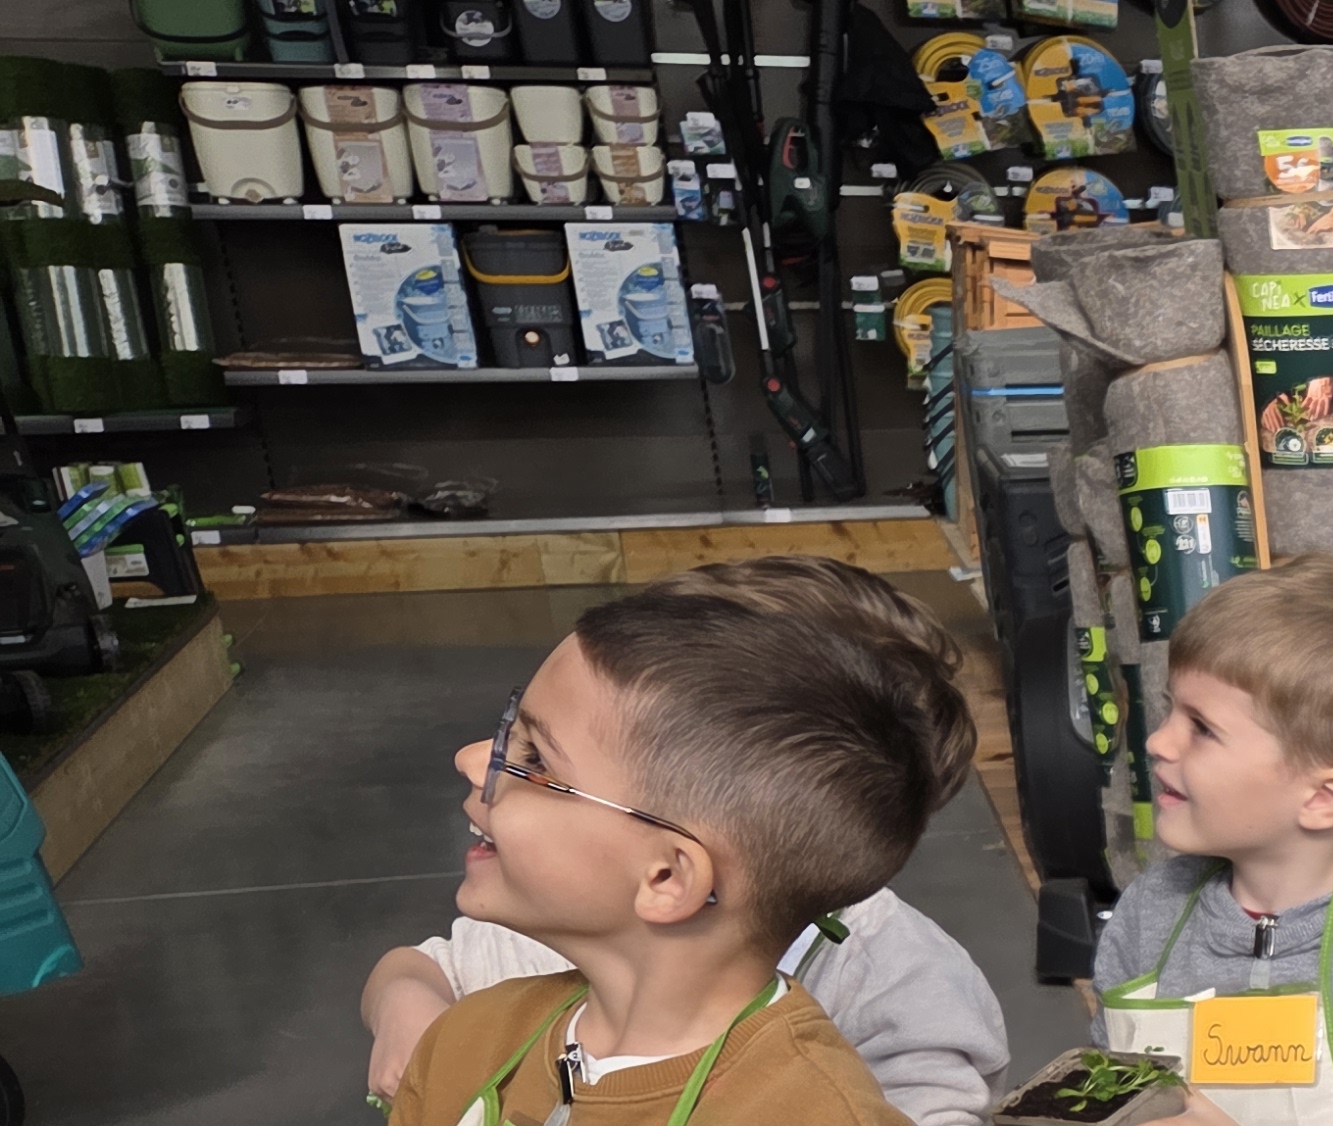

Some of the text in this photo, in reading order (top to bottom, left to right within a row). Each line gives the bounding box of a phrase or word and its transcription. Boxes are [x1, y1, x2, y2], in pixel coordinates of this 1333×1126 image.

[1251, 324, 1311, 337] PAILLAGE
[1252, 337, 1330, 352] SÉCHERESSE
[1203, 1023, 1312, 1067] Swann
